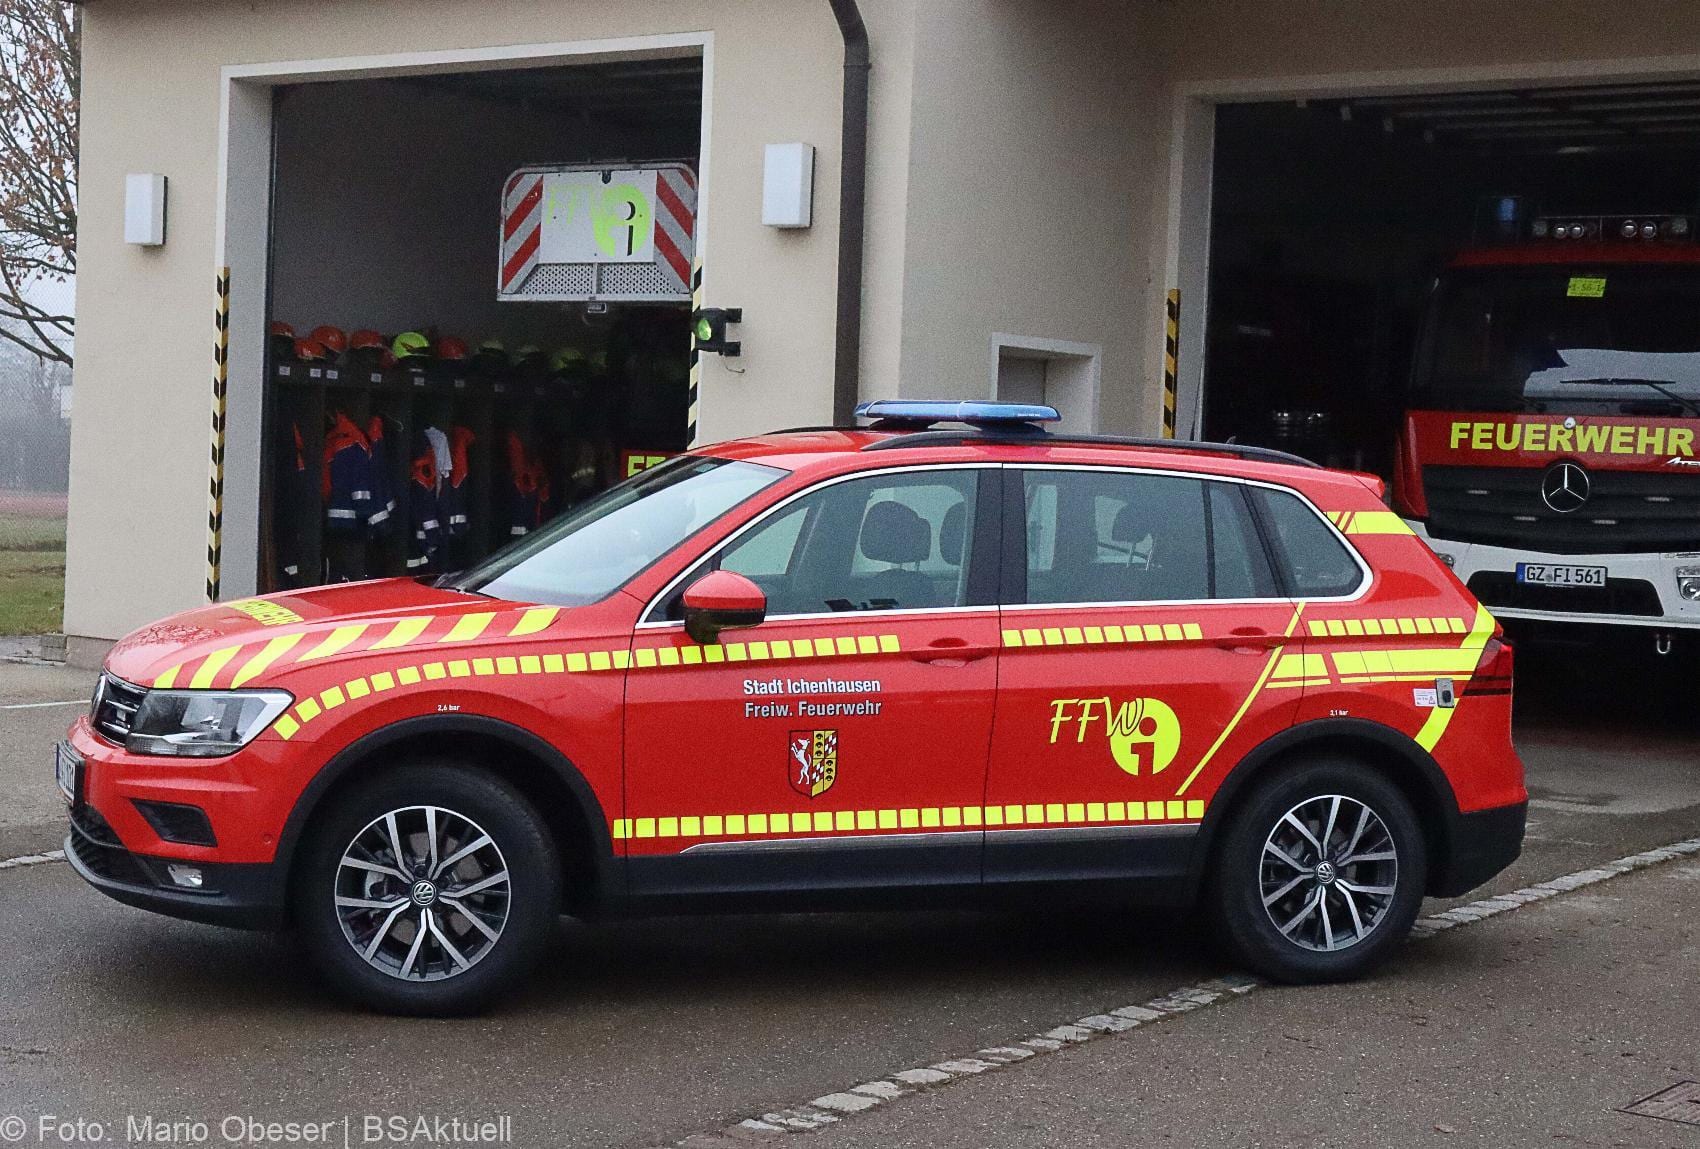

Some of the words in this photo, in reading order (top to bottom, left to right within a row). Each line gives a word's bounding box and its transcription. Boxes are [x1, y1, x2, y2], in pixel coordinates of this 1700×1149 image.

[1450, 422, 1694, 456] FEUERWEHR
[1526, 566, 1545, 581] GZ
[1553, 568, 1571, 583] FI
[1575, 569, 1602, 584] 561
[743, 679, 783, 695] Stadt
[787, 678, 881, 694] Ichenhausen
[745, 702, 793, 718] Freiw.
[798, 700, 882, 716] Feuerwehr
